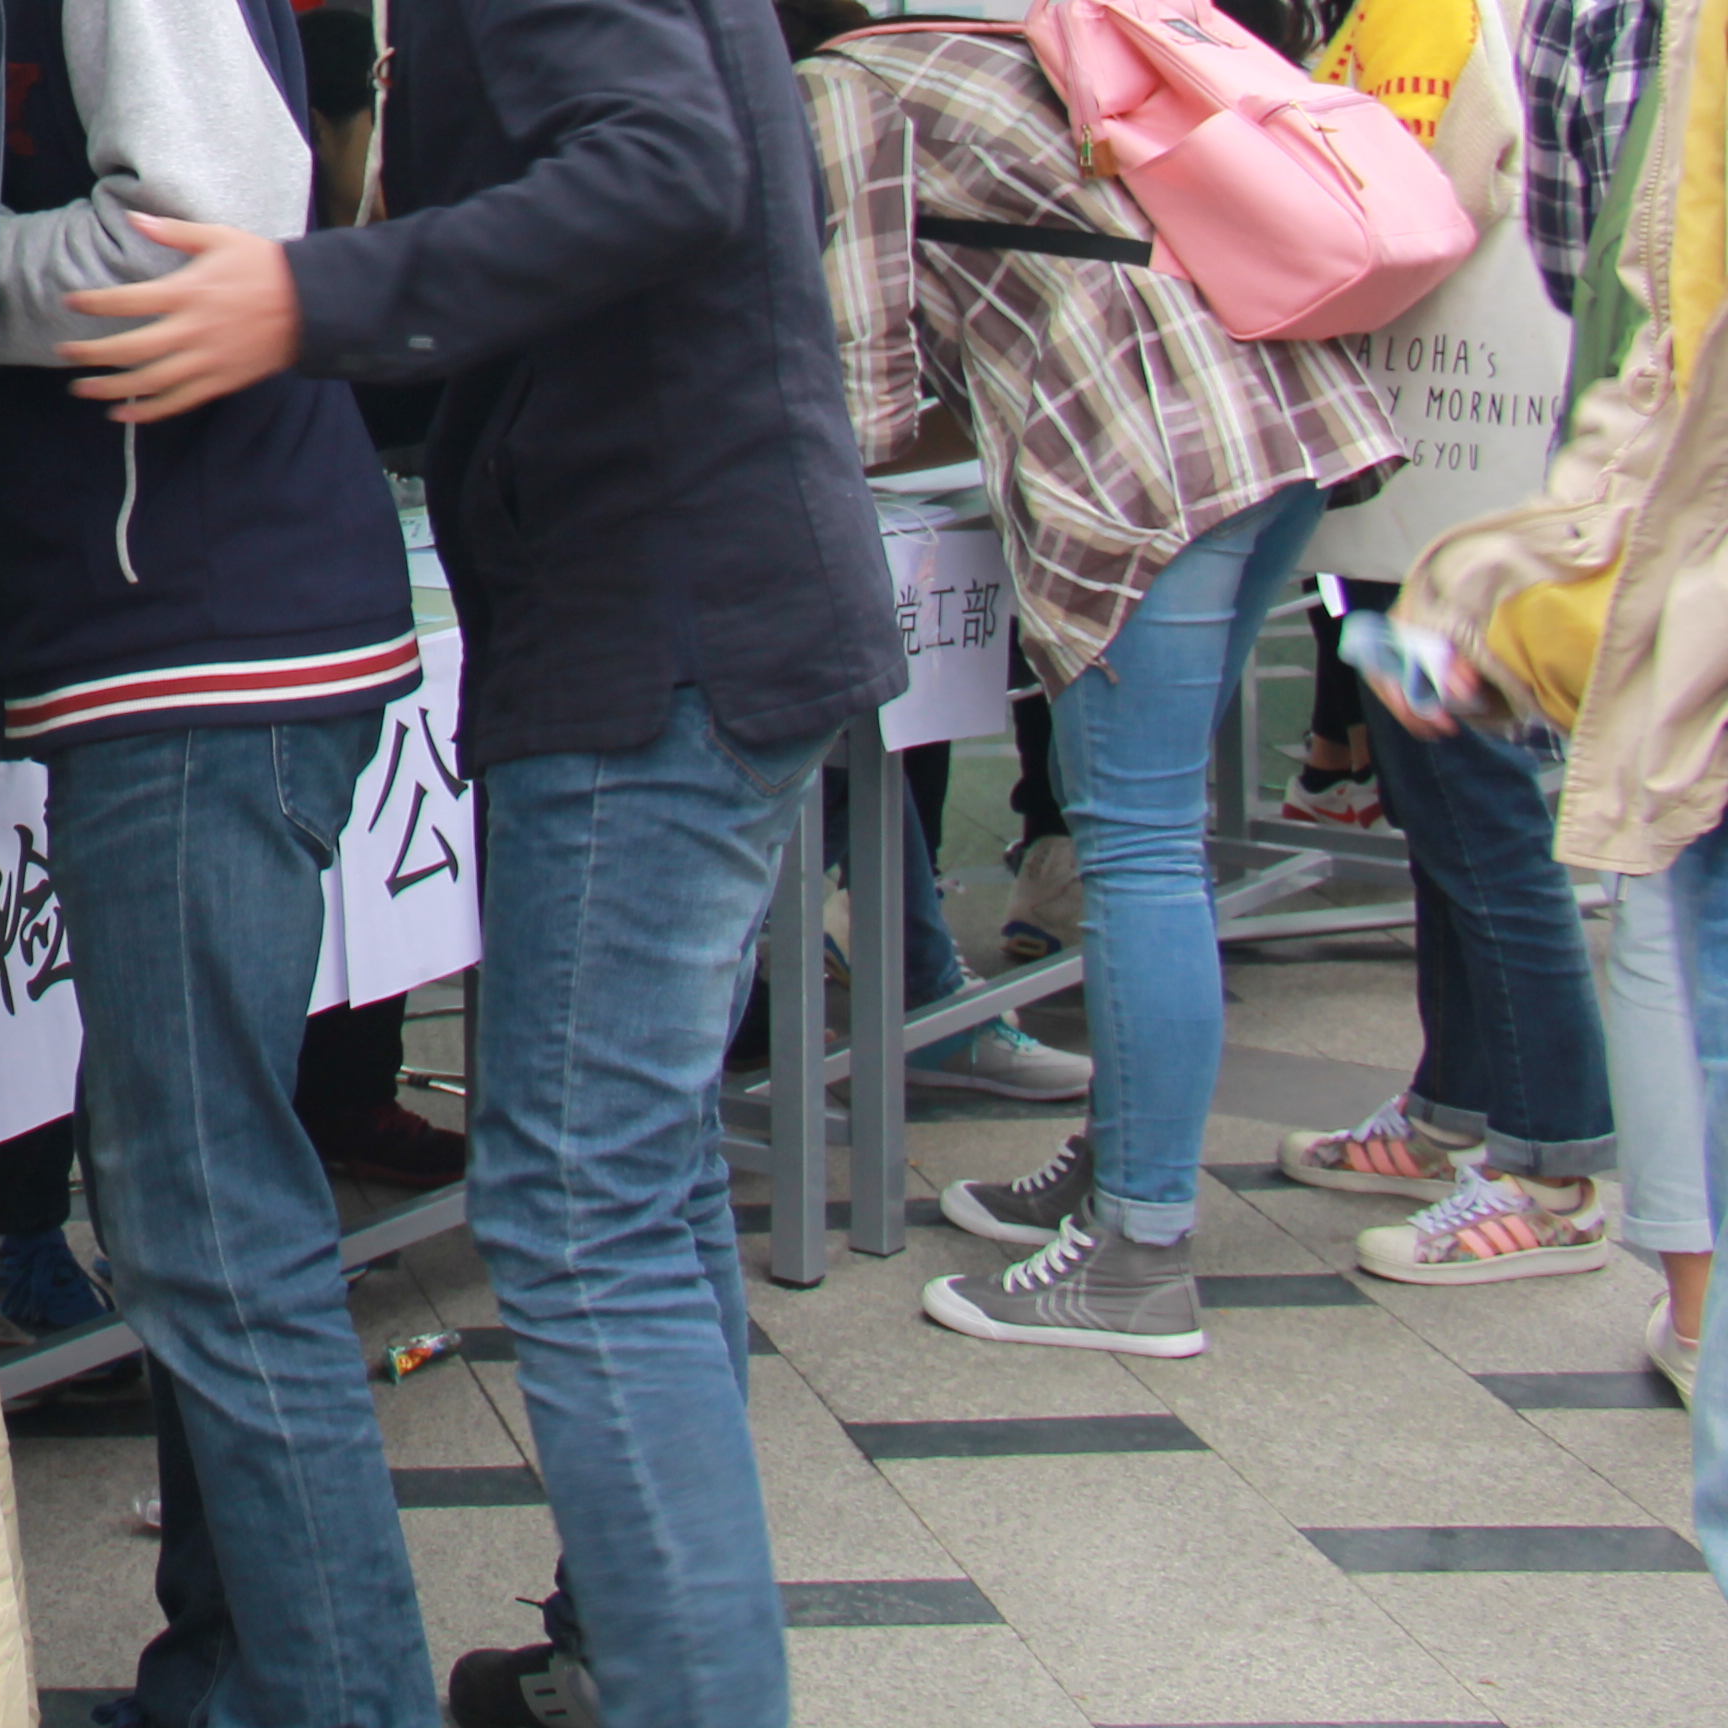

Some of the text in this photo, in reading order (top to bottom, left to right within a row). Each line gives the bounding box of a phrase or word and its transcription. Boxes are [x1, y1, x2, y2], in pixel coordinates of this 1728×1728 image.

[894, 578, 1001, 657] 党工部
[368, 707, 469, 900] 公
